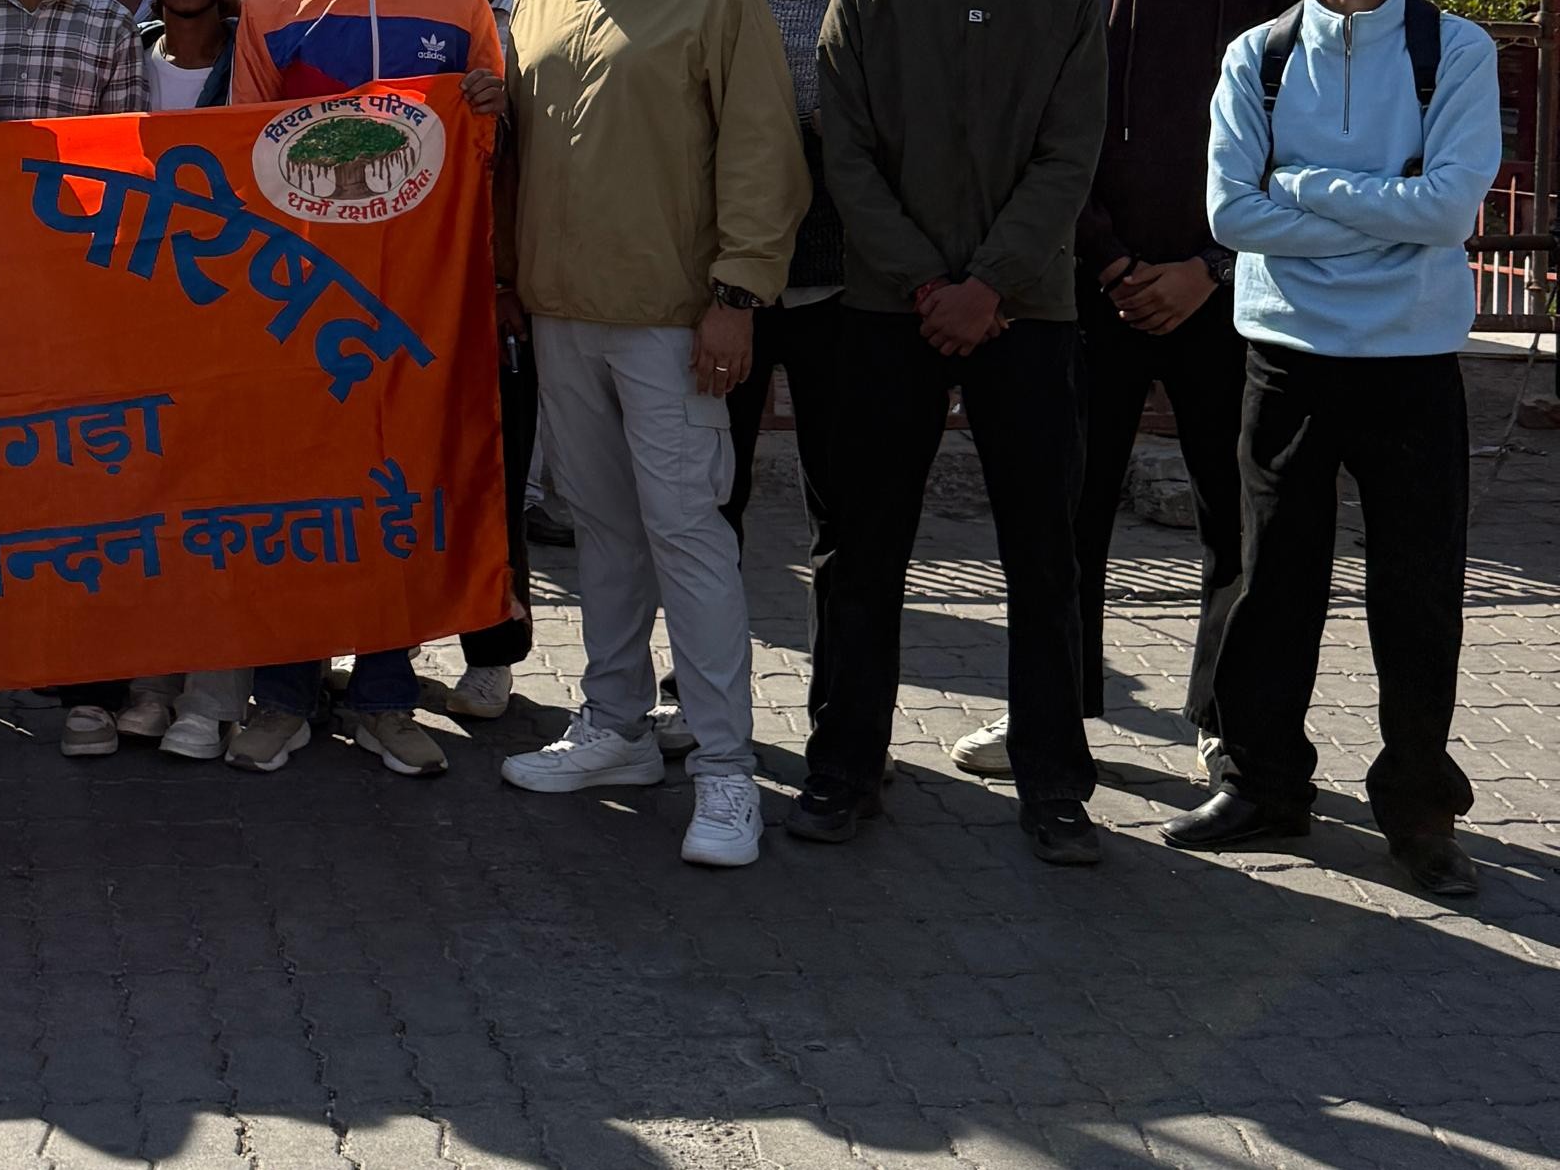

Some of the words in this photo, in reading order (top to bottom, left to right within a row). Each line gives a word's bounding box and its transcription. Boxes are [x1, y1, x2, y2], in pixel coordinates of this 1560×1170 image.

[417, 50, 446, 63] adidas
[265, 104, 313, 144] विश्व
[368, 93, 429, 127] परिषद
[22, 145, 436, 403] परिषद
[182, 497, 365, 570] करता
